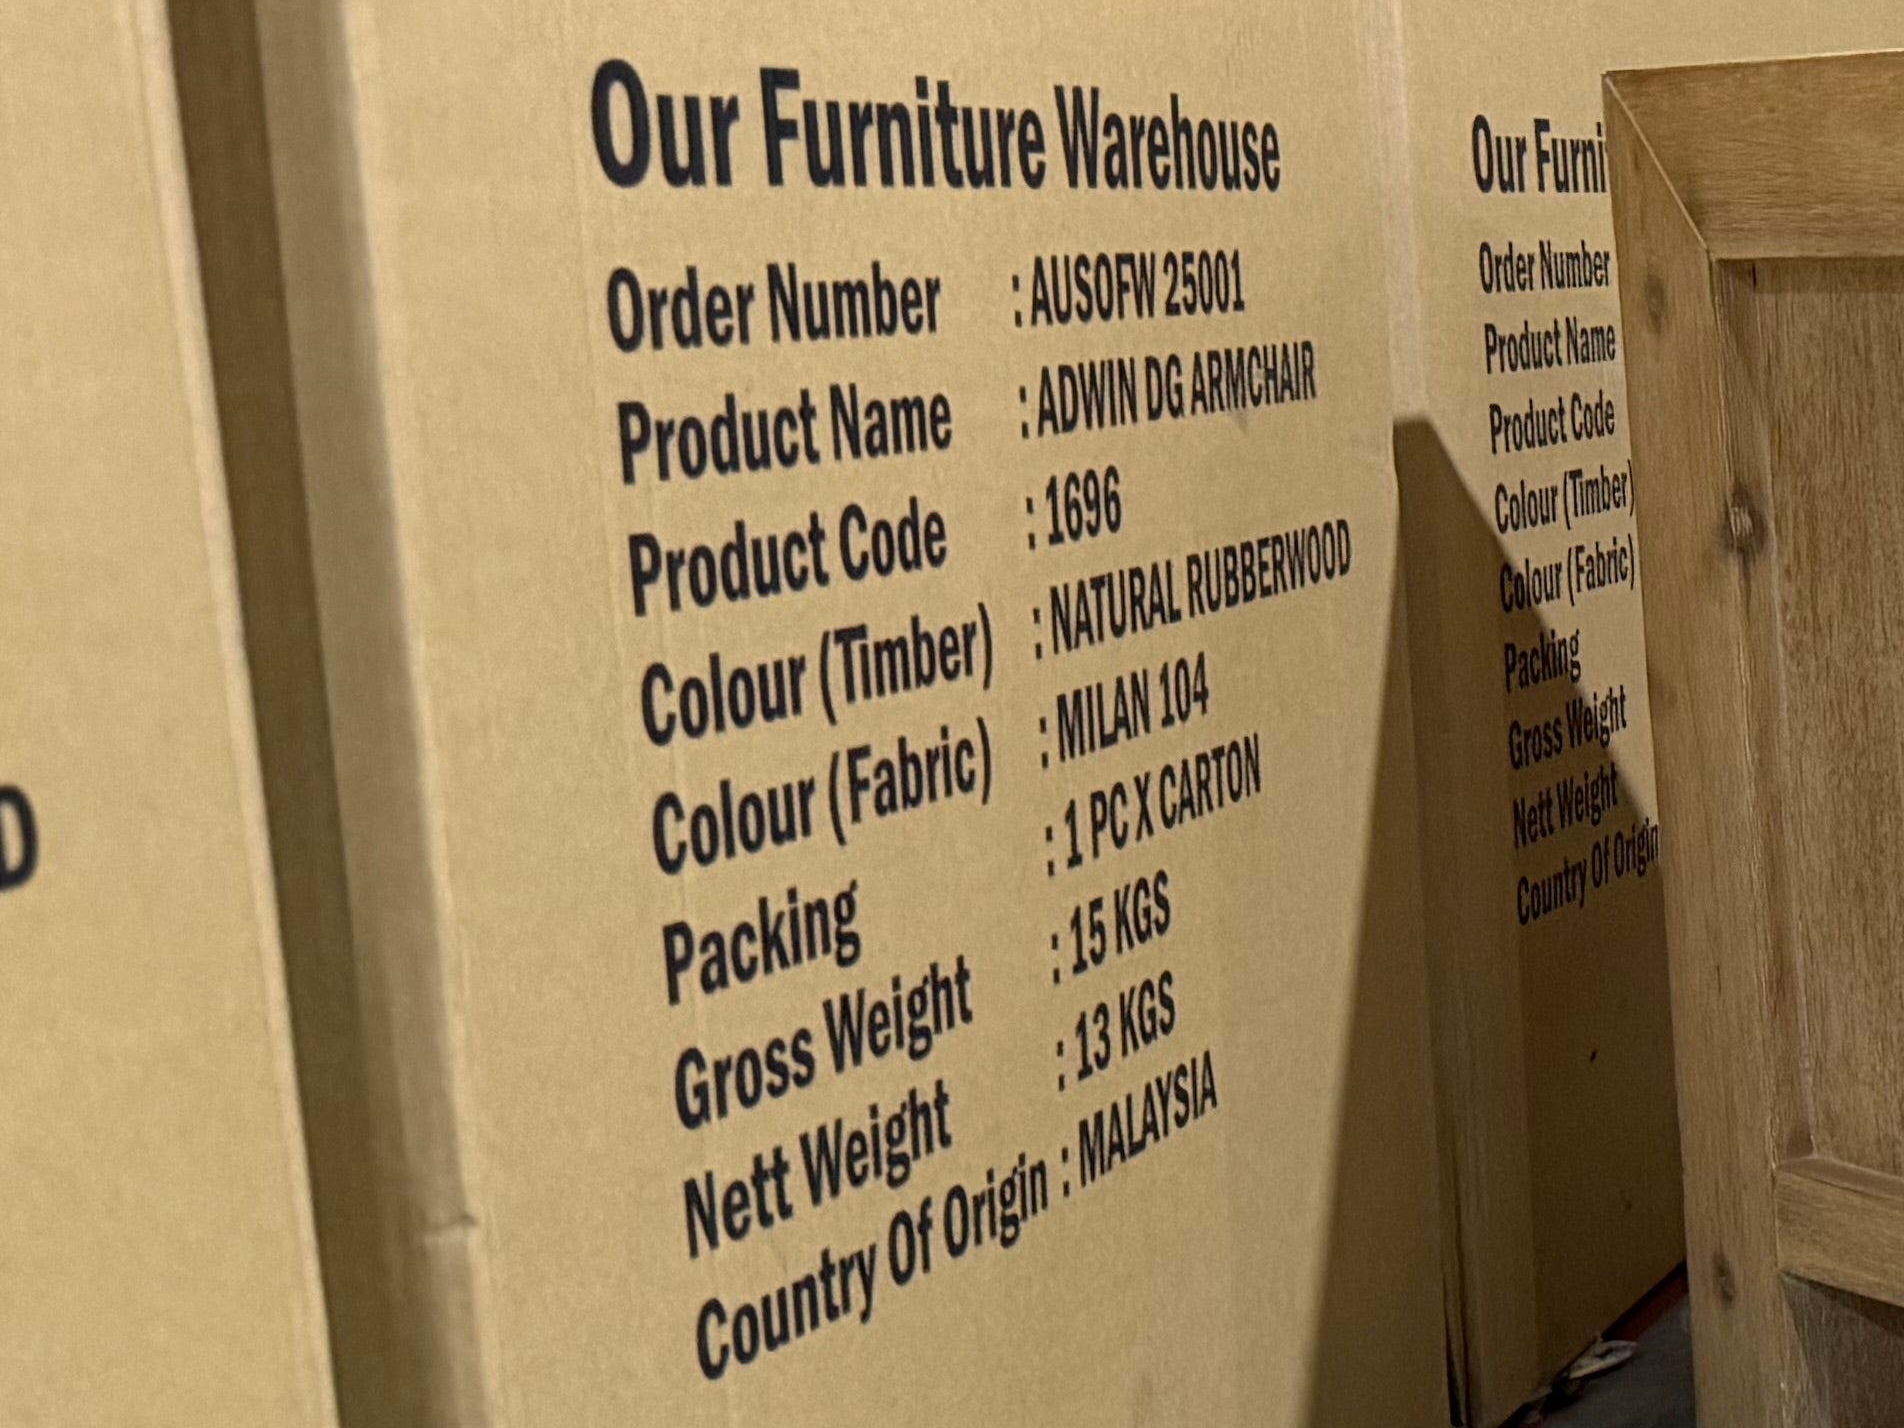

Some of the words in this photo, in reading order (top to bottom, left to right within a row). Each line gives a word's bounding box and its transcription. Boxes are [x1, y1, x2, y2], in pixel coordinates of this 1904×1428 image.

[589, 58, 740, 188] Our
[759, 66, 1046, 189] Furniture
[1053, 84, 1280, 192] Warehouse
[1471, 113, 1527, 193] Our
[606, 265, 755, 353] Order
[765, 259, 940, 343] Number
[1030, 251, 1156, 326] AUSOFW
[1162, 248, 1245, 316] 25001
[1478, 241, 1536, 294] Order
[1538, 238, 1610, 291] Number
[1484, 318, 1562, 374] Product
[1564, 315, 1616, 366] Name
[616, 387, 820, 485] Product
[828, 382, 952, 461] Name
[1037, 356, 1138, 437] ADWIN
[1144, 353, 1184, 421] DG
[1190, 340, 1316, 415] ARMCHAIR
[1488, 395, 1567, 455] Product
[1570, 388, 1615, 441] Code
[627, 510, 830, 617] Product
[838, 495, 947, 581] Code
[1045, 464, 1121, 546] 1696
[1495, 477, 1558, 534] Colour
[1563, 459, 1634, 530] (Timber)
[1501, 550, 1562, 613] Colour
[1566, 534, 1634, 607] (Fabric)
[640, 651, 806, 746] Colour
[819, 601, 992, 726] (Timber)
[1049, 558, 1182, 655] NATURAL
[1186, 518, 1351, 618] RUBBERWOOD
[1503, 627, 1581, 694] Packing
[652, 775, 815, 875] Colour
[828, 716, 991, 846] (Fabric)
[1056, 667, 1150, 762] MILAN
[1159, 651, 1209, 728] 104
[1508, 714, 1563, 770] Gross
[1565, 684, 1627, 751] Weight
[1512, 787, 1554, 851] Nett
[1556, 762, 1618, 832] Weight
[661, 878, 861, 1006] Packing
[1064, 798, 1083, 869] 1
[1089, 781, 1128, 859] PC
[1133, 771, 1154, 842] X
[1158, 731, 1260, 829] CARTON
[1516, 856, 1588, 926] Country
[1591, 834, 1611, 889] Of
[1613, 816, 1660, 880] Origin
[674, 1027, 815, 1130] Gross
[821, 954, 973, 1074] Weight
[1069, 896, 1106, 975] 15
[1113, 869, 1170, 954] KGS
[683, 1145, 793, 1259] Nett
[798, 1078, 952, 1207] Weight
[1074, 1001, 1111, 1081] 13
[1118, 969, 1175, 1058] KGS
[695, 1242, 876, 1380] Country
[887, 1195, 933, 1286] Of
[943, 1151, 1048, 1258] Origin
[1078, 1049, 1217, 1188] MALAYSIA
